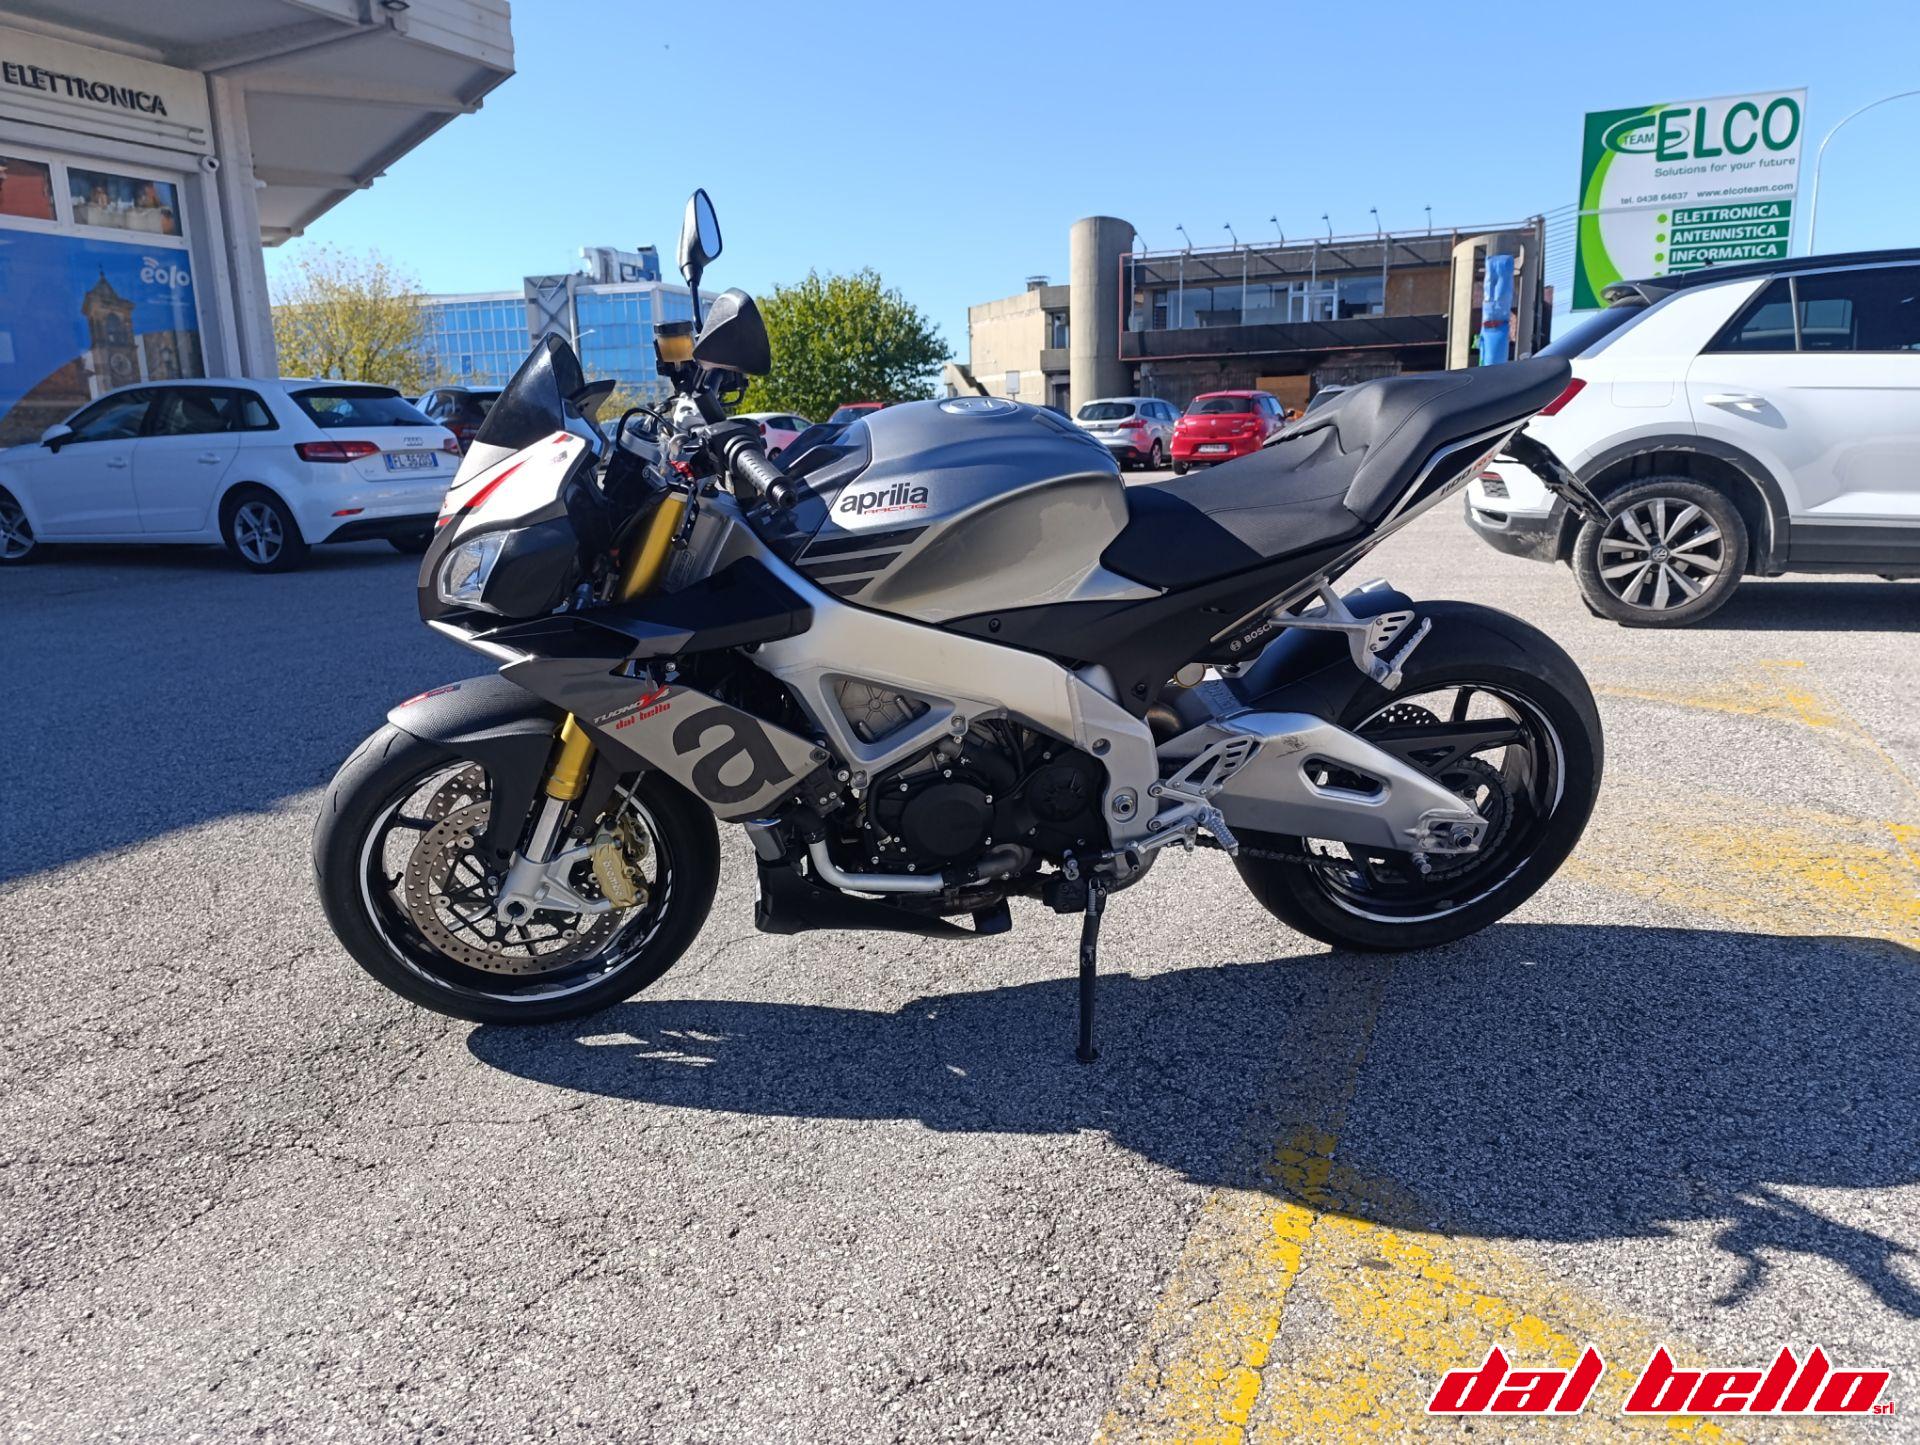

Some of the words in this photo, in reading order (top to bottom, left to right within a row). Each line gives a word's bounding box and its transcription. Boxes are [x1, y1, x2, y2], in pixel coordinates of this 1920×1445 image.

[2, 60, 168, 117] ELETTRONICA
[1622, 132, 1655, 146] TEAM
[1656, 97, 1800, 162] ELCO
[1654, 164, 1708, 178] Solutions
[1710, 162, 1728, 173] for
[1730, 160, 1756, 173] your
[1759, 157, 1796, 167] future
[1621, 196, 1633, 205] tel.
[1636, 194, 1659, 204] 0438
[1696, 182, 1794, 199] www.elcoteam.com
[1673, 204, 1780, 225] ELETTRONICA
[1672, 224, 1777, 244] ANTENNISTICA
[1671, 244, 1778, 262] INFORMATICA
[840, 482, 929, 515] aprilia
[615, 715, 636, 730] dal
[639, 703, 671, 721] bello
[672, 705, 796, 805] a
